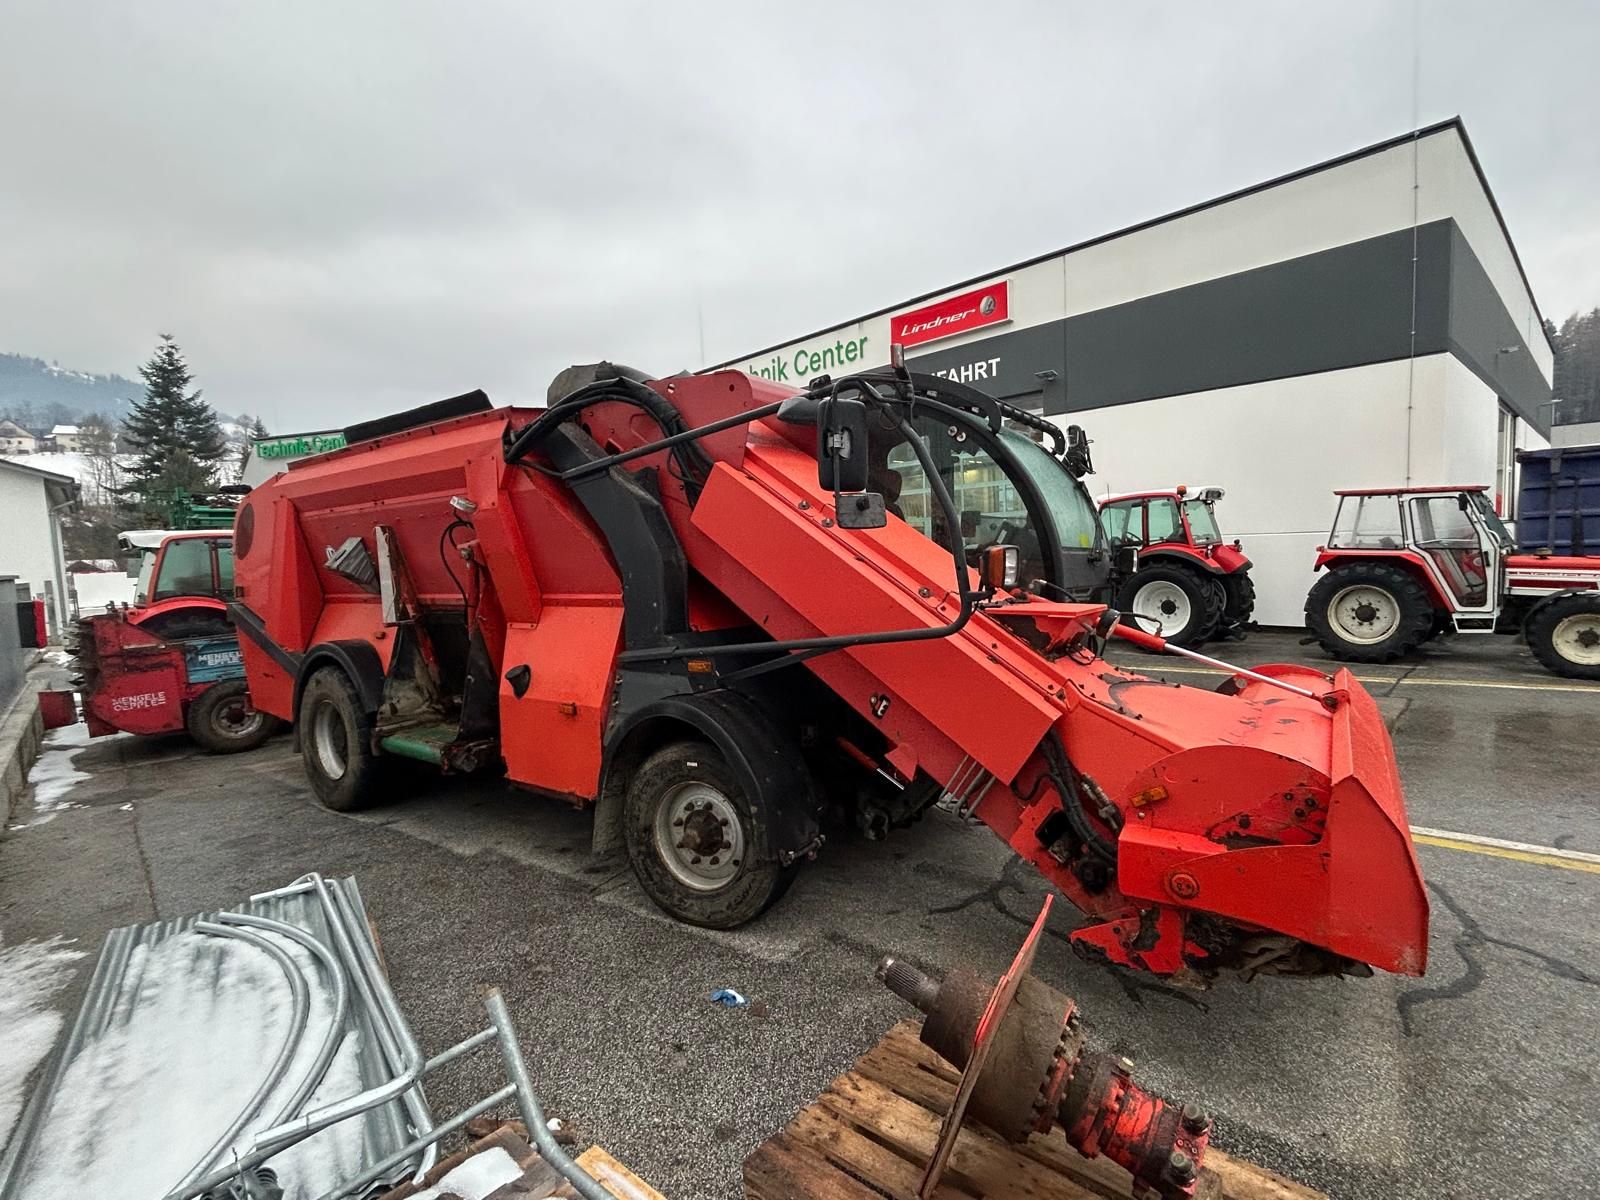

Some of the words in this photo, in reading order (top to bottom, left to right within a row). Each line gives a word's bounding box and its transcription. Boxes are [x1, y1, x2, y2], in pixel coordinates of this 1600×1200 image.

[901, 308, 976, 337] Lindner
[794, 336, 868, 376] Center
[256, 436, 306, 459] Technik
